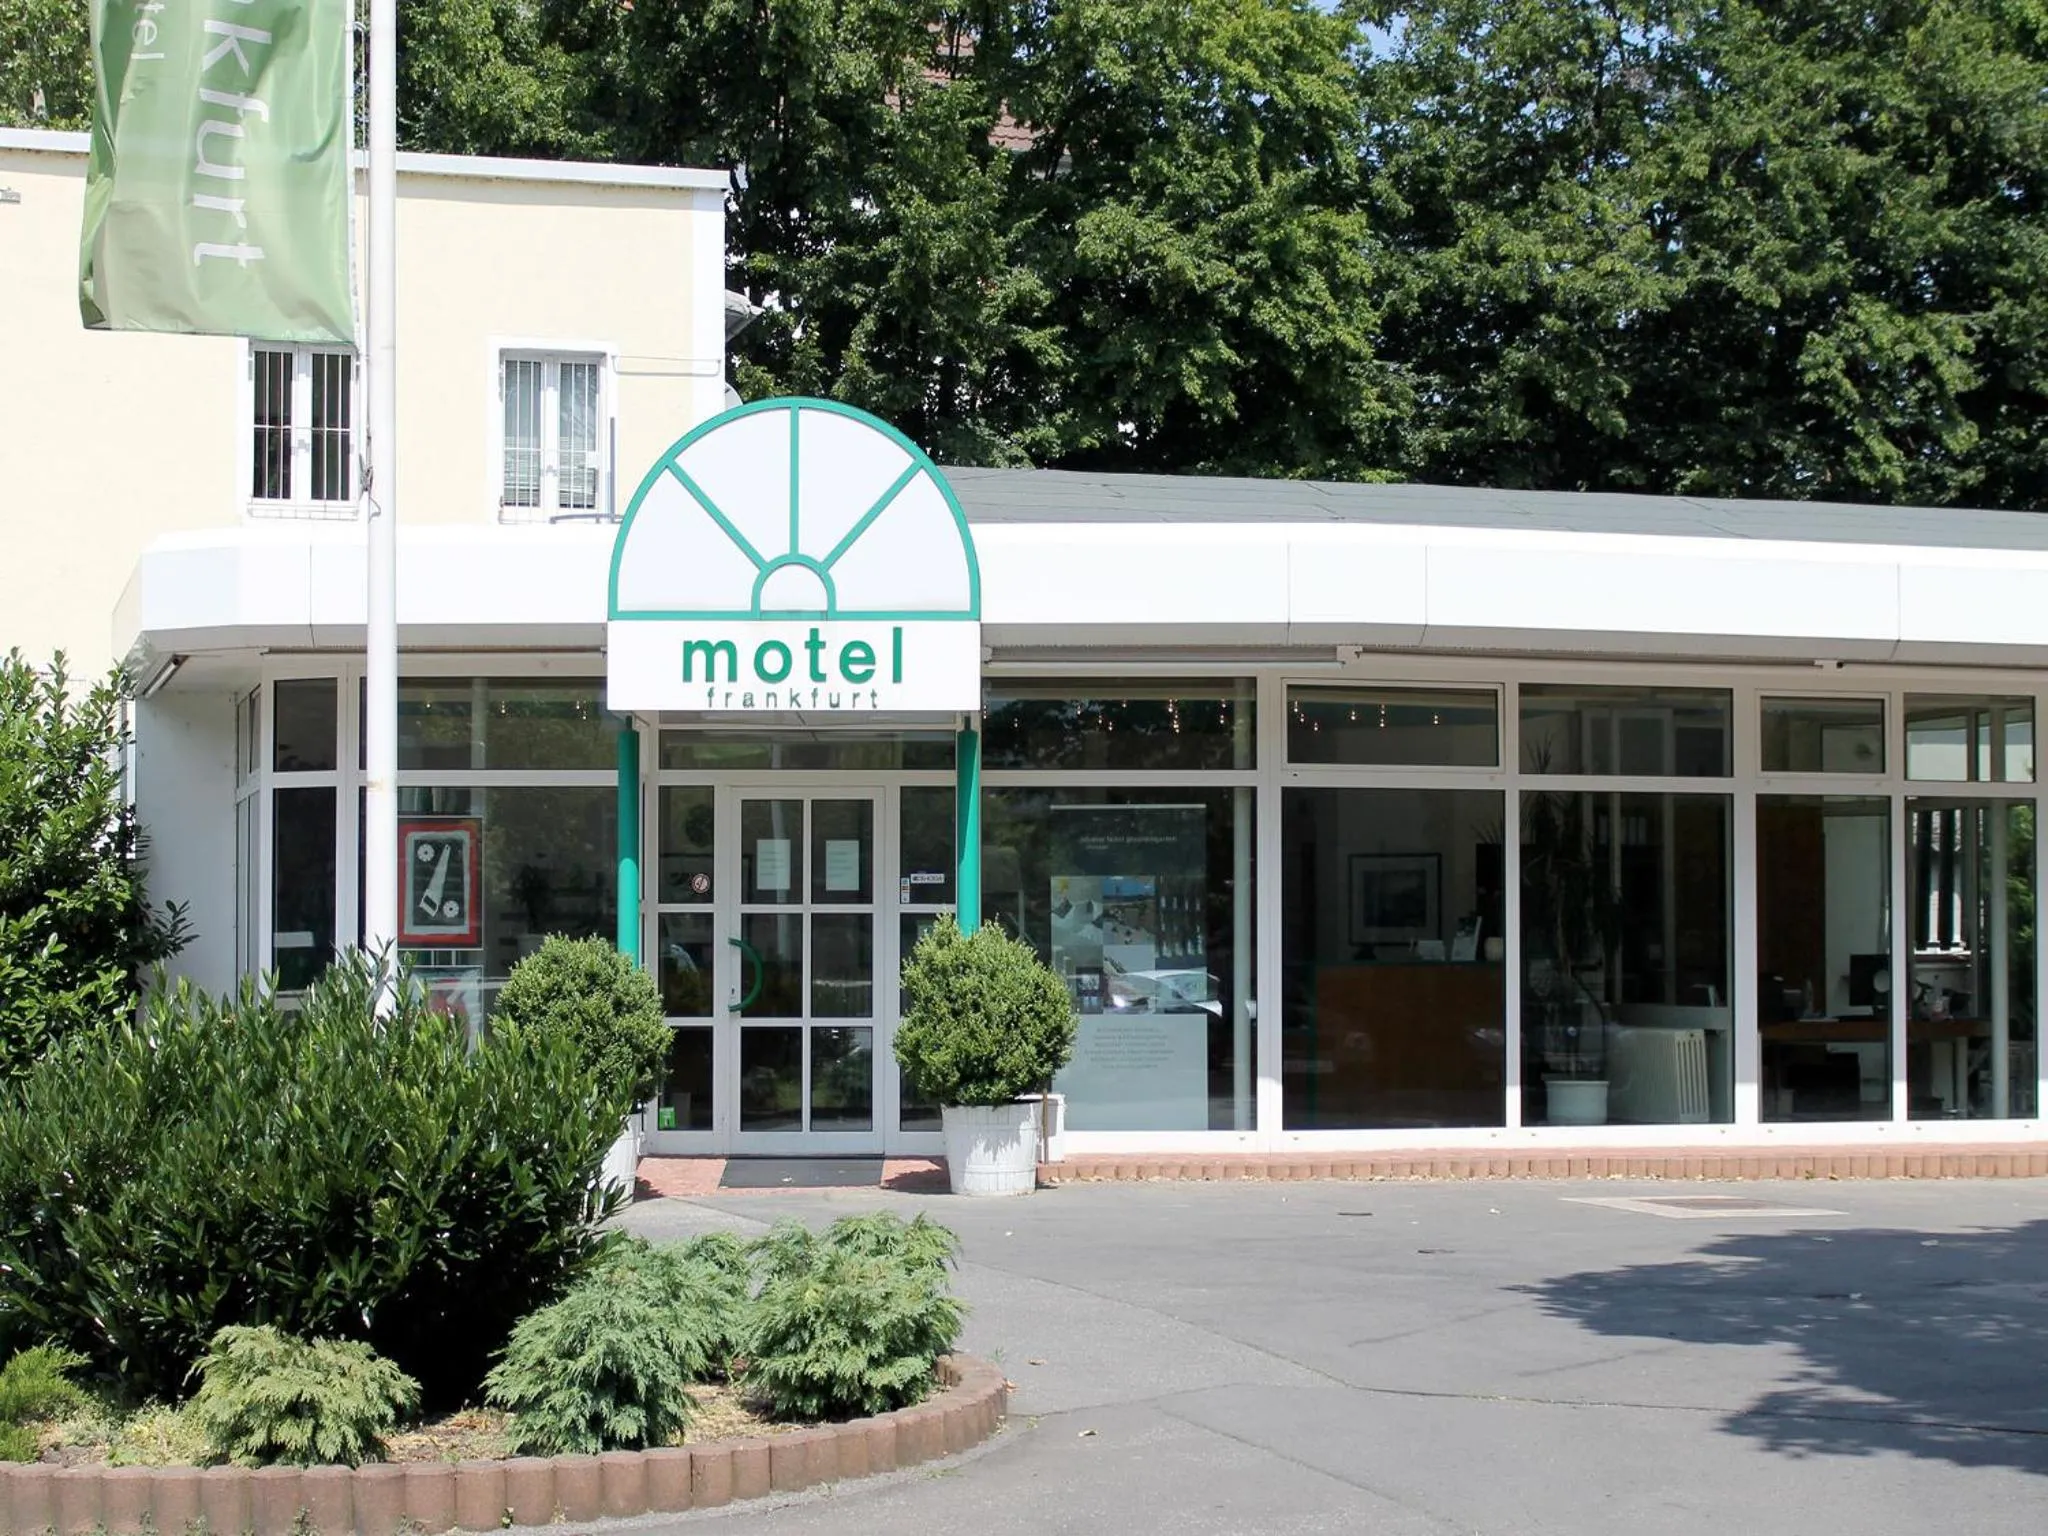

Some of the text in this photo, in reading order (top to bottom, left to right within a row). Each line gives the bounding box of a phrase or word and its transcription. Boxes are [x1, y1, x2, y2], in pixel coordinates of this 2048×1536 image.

[193, 0, 272, 269] kfurt
[682, 627, 903, 684] motel
[707, 687, 879, 709] frankfurt
